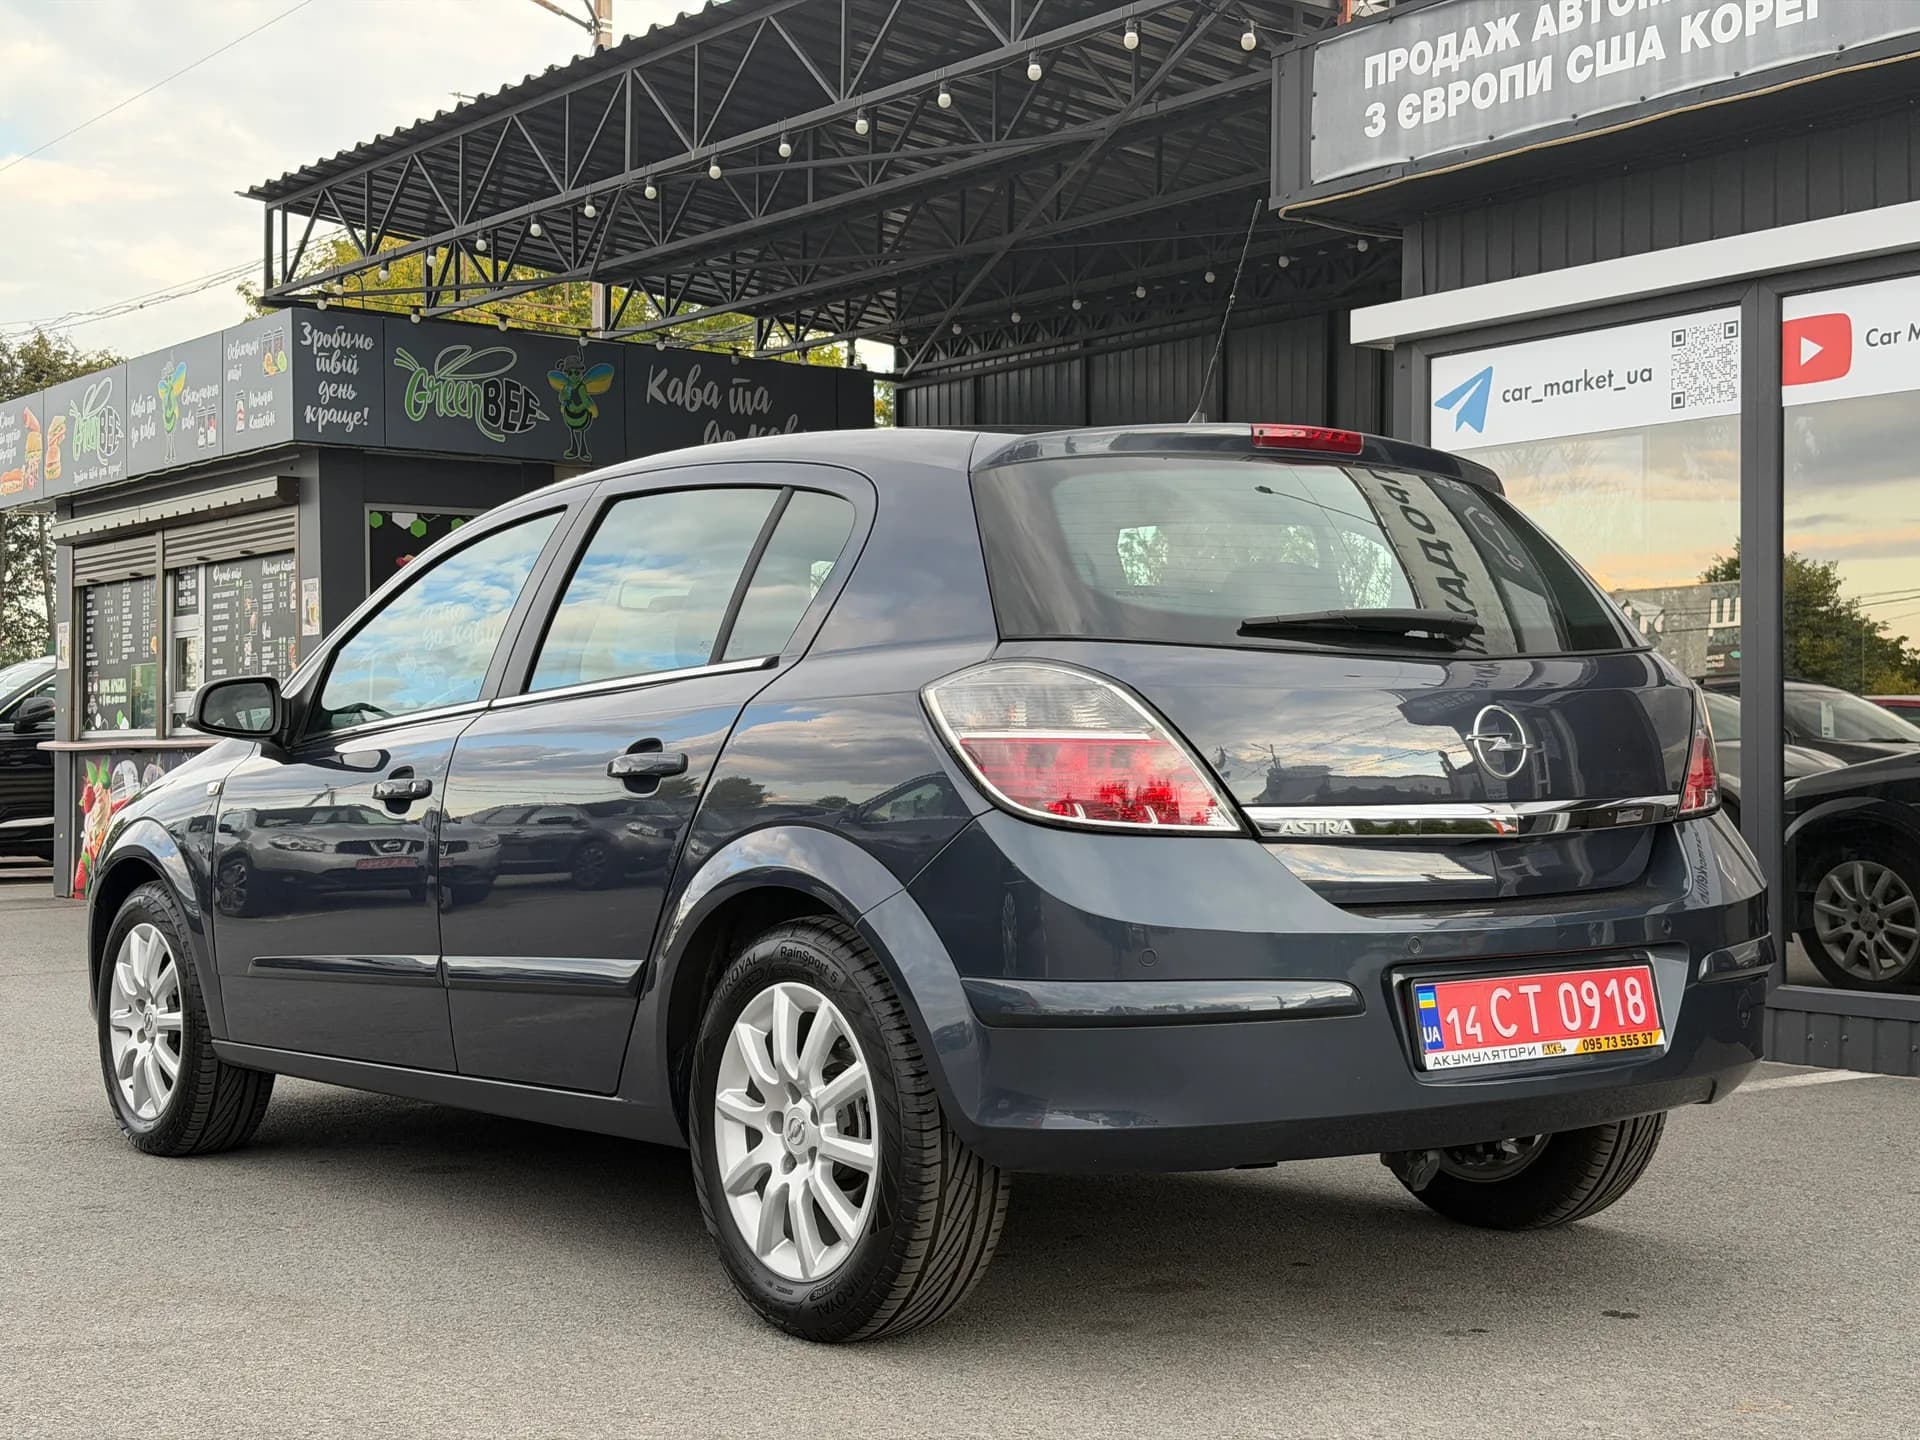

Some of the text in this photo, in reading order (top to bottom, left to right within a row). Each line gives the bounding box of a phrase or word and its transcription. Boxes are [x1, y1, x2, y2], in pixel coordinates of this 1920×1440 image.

[1364, 0, 1670, 89] ПРОДАЖ АВТ
[1364, 102, 1386, 138] З
[1397, 54, 1553, 130] ЄВРОПИ
[1566, 25, 1666, 84] США
[300, 321, 375, 355] Зробимо
[1865, 327, 1902, 348] Car
[315, 349, 360, 375] твій
[318, 380, 358, 404] день
[646, 363, 773, 415] Кава та
[1501, 367, 1653, 404] car_market_ua
[304, 404, 369, 433] краще!
[1280, 819, 1356, 835] ASTRA
[780, 946, 830, 974] RainSport
[1557, 976, 1647, 1032] 0918
[1423, 1026, 1442, 1044] UA
[1582, 1032, 1653, 1052] 095 73 555 37
[1432, 1046, 1537, 1068] АКУМУЛЯТОРИ
